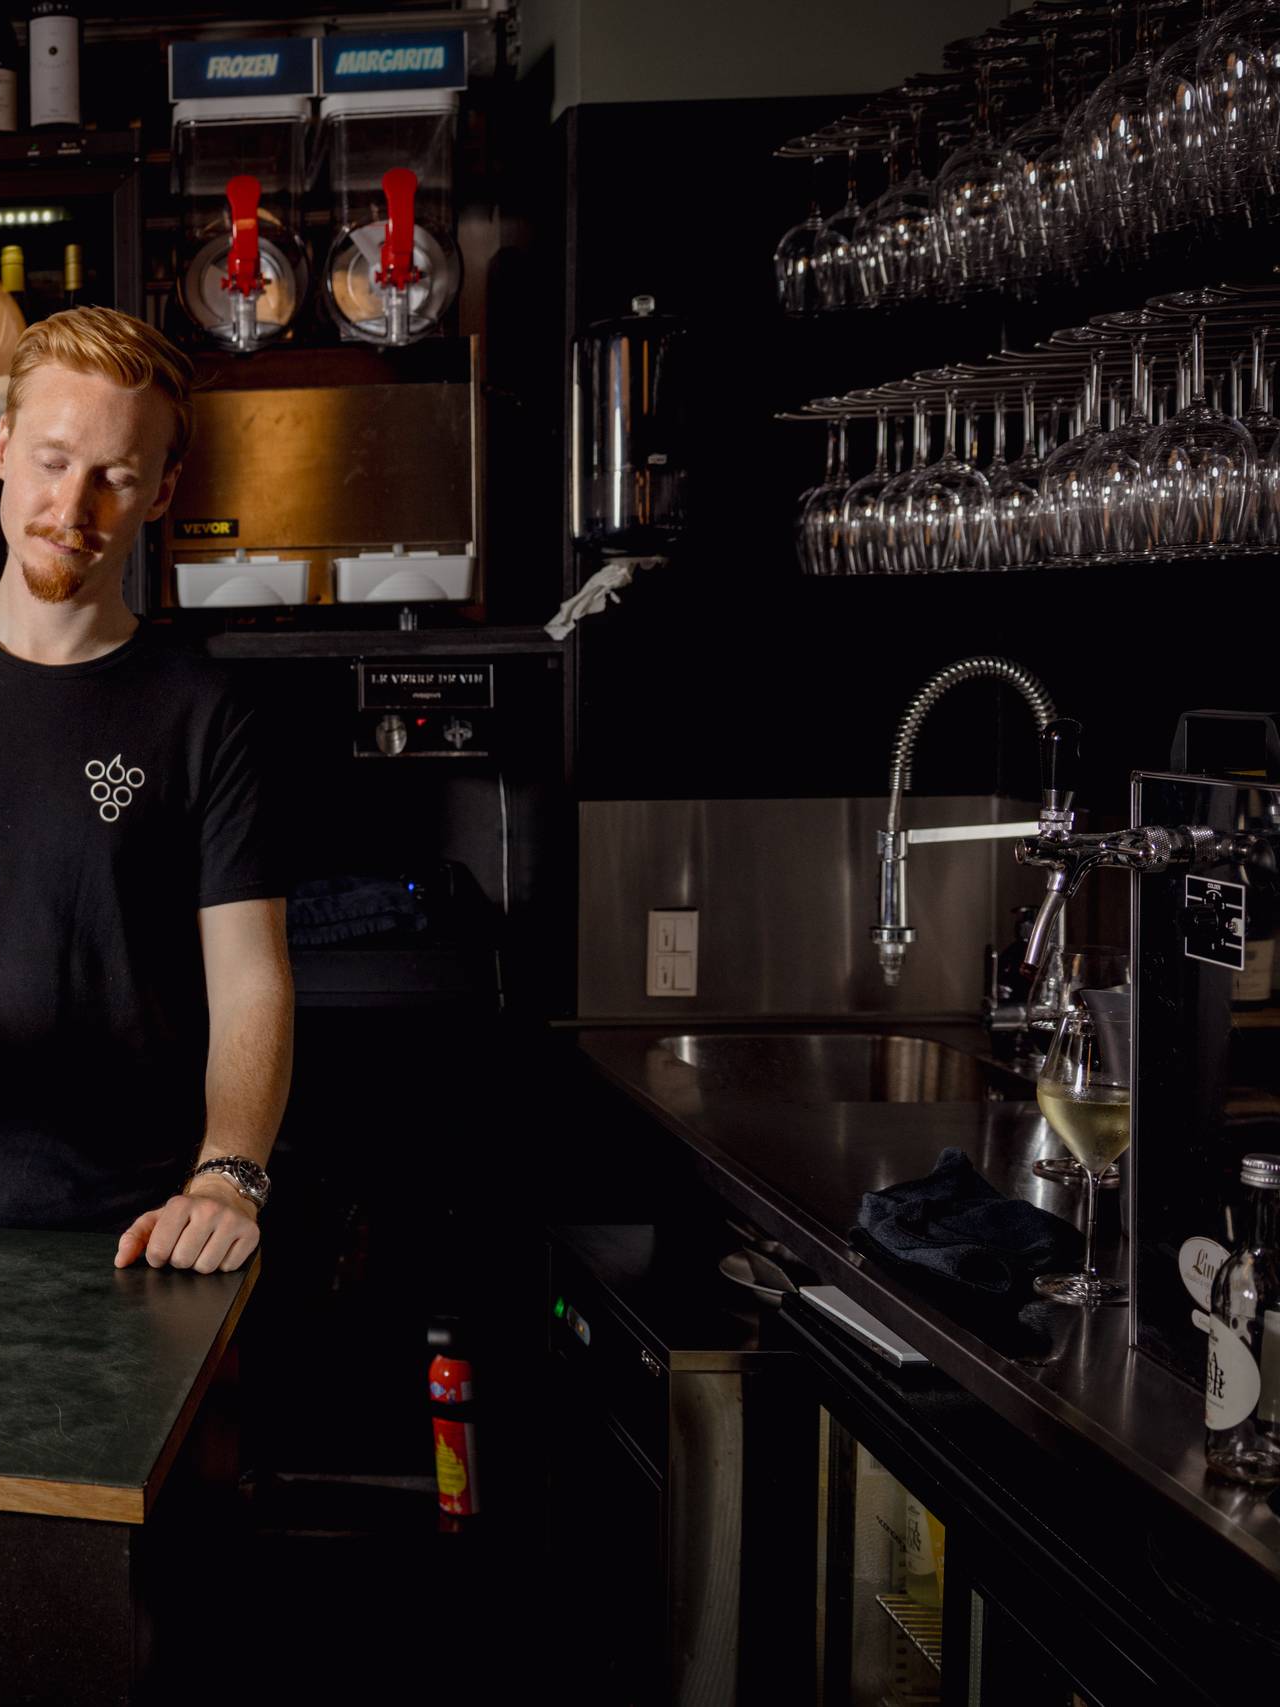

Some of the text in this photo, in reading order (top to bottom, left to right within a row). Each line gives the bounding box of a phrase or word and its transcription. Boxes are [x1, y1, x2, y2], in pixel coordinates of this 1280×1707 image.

[206, 53, 280, 79] FROZEN
[334, 46, 445, 75] MARGARITA
[183, 521, 231, 535] VEVOR
